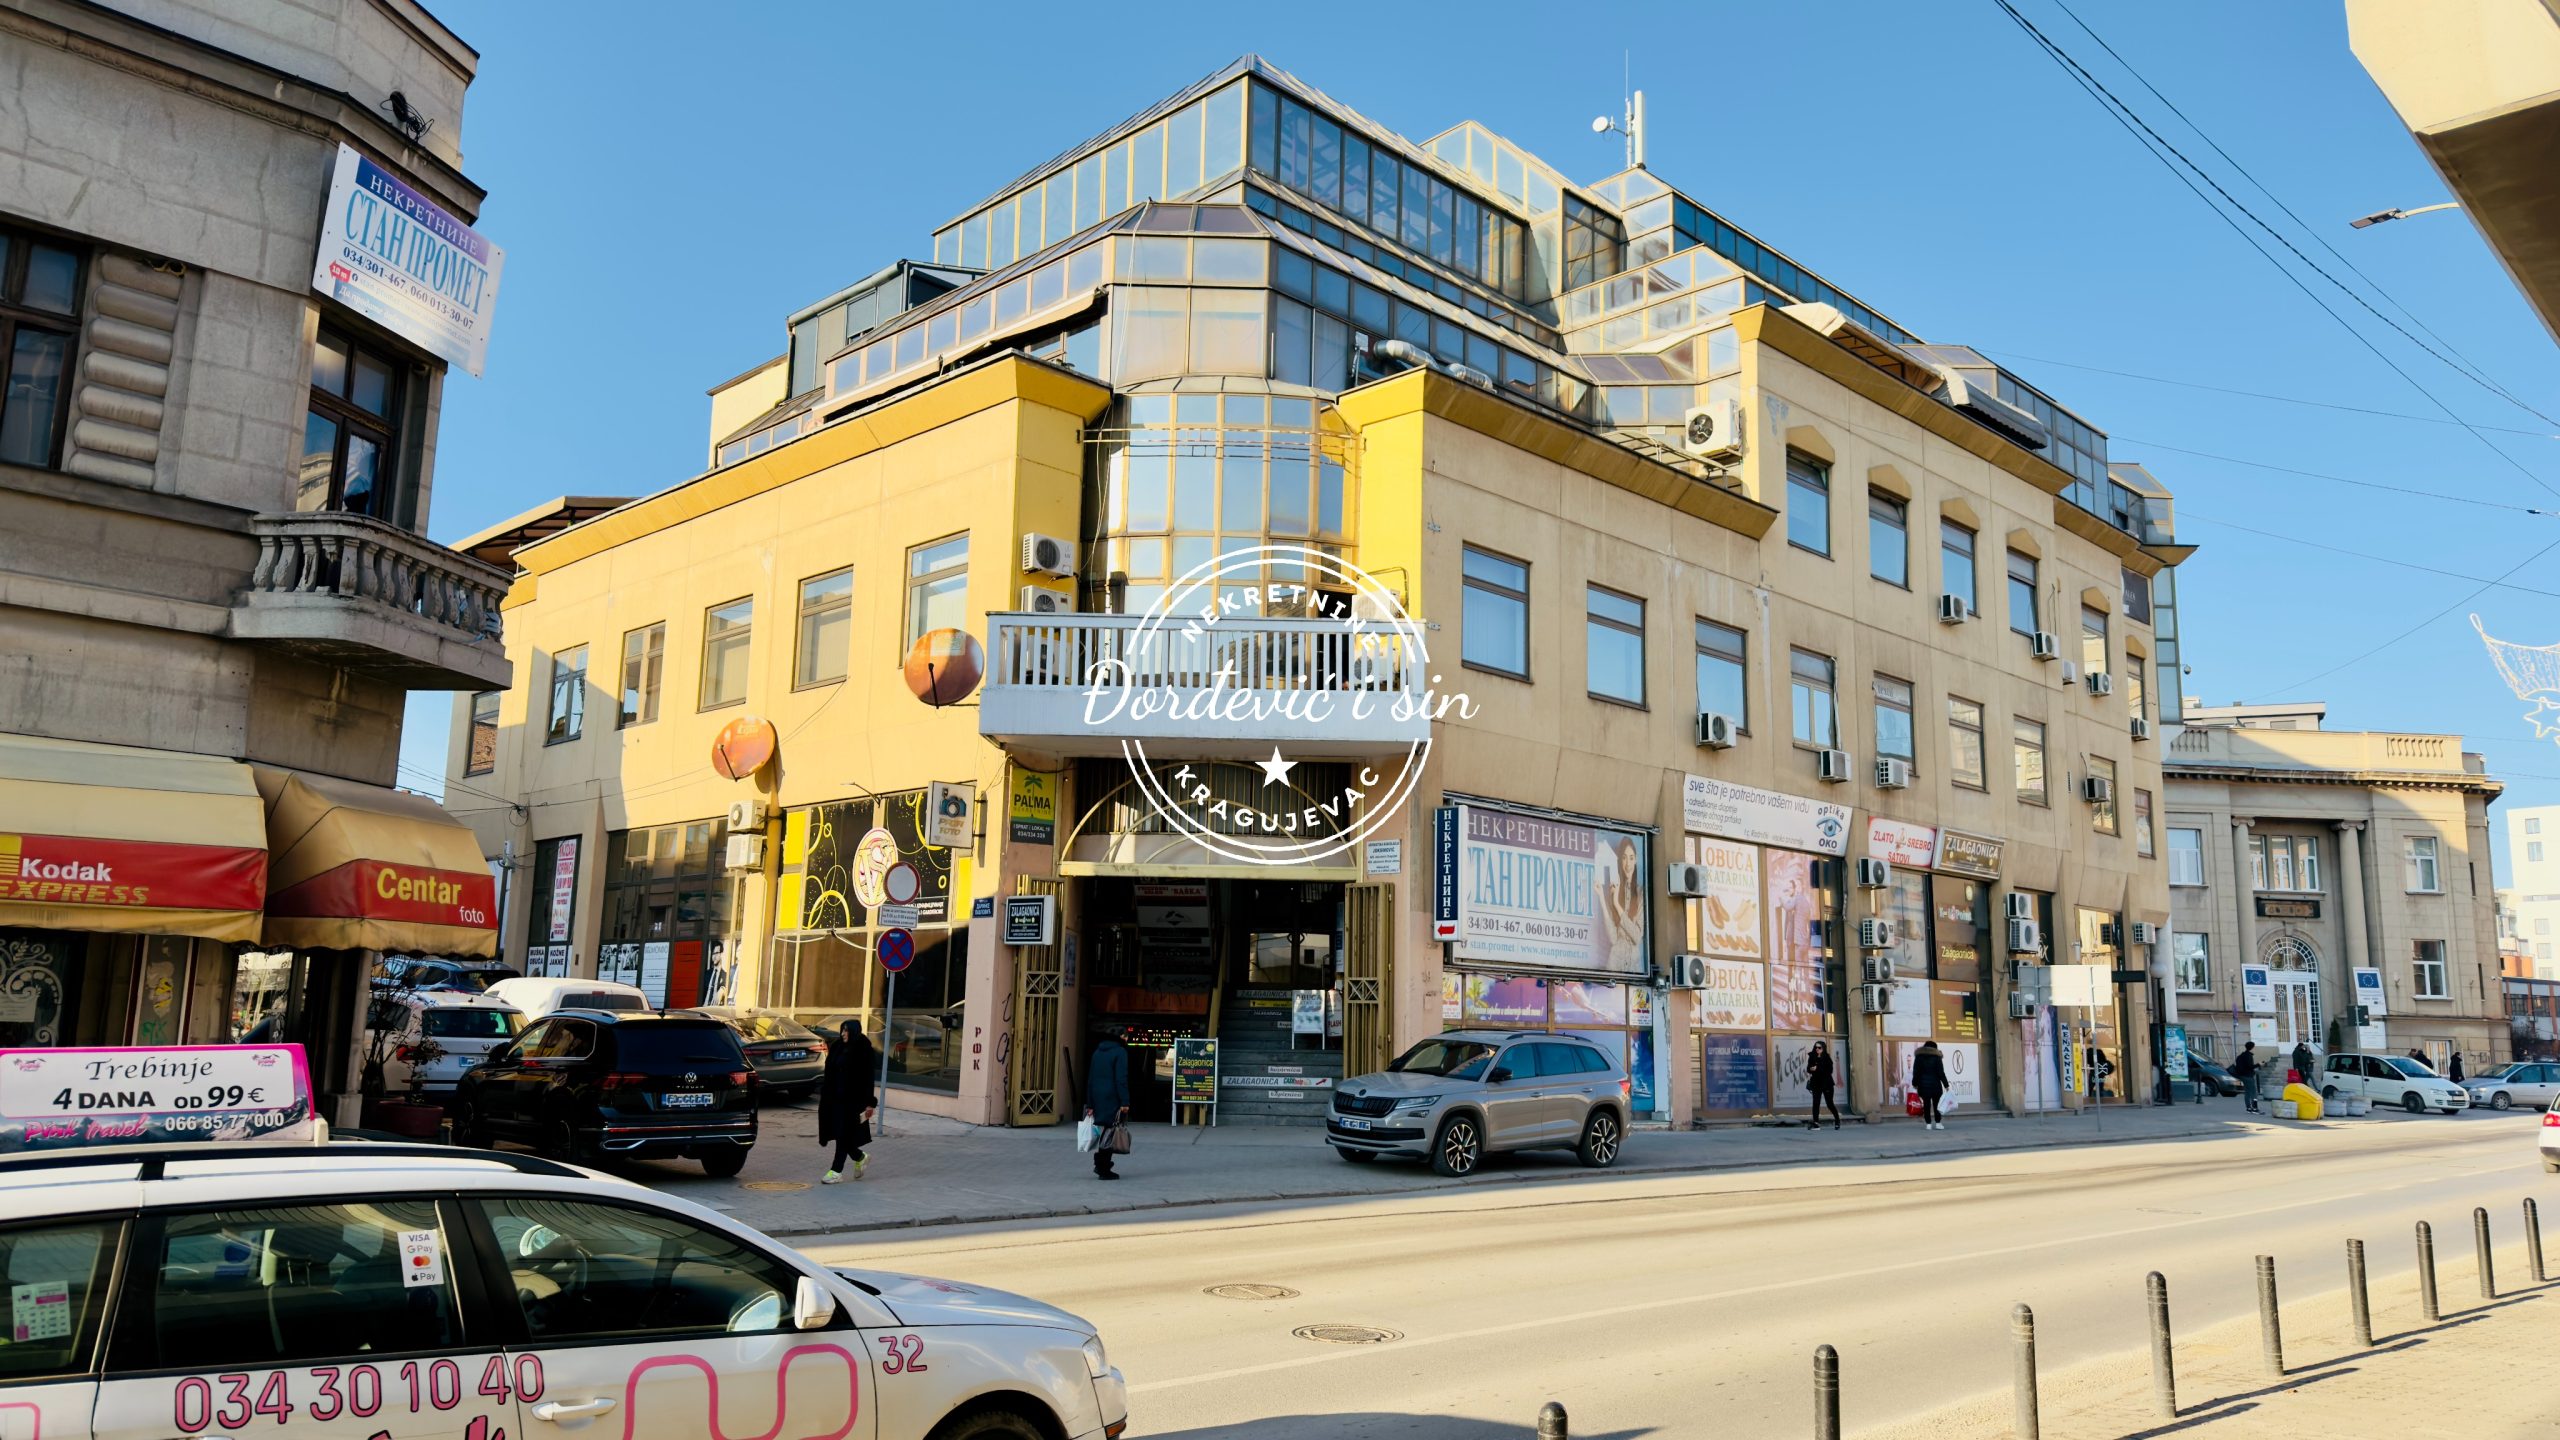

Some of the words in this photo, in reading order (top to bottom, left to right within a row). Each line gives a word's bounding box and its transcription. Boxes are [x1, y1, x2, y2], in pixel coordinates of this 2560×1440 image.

[369, 174, 479, 257] НЕКРЕТНИНЕ
[345, 189, 408, 268] СТАН
[404, 224, 489, 315] ПРОМЕТ
[1013, 793, 1051, 810] PALMA
[1689, 779, 1705, 793] sve
[1706, 782, 1719, 796] šta
[1719, 785, 1728, 800] je
[1729, 786, 1766, 806] potrebno
[1767, 793, 1793, 810] vašem
[1794, 799, 1810, 814] vidu
[1817, 804, 1845, 821] optika
[1468, 813, 1591, 853] НЕКРЕТНИНЕ
[1873, 831, 1895, 843] ZLATO
[1907, 838, 1932, 851] SREBRO
[1818, 838, 1838, 849] OKO
[1945, 837, 1999, 859] ZALAGAONICA
[1442, 809, 1452, 919] НЕКРЕТНИНЕ
[1705, 847, 1754, 873] OBUĆA
[1887, 851, 1911, 864] SATOVI
[21, 857, 113, 882] Kodak
[376, 867, 463, 905] Centar
[1467, 845, 1513, 908] ТАН
[1517, 852, 1595, 917] ПРОМЕТ
[0, 879, 150, 905] EXPRESS
[459, 906, 485, 924] foto
[1010, 905, 1040, 917] ZALAGAONICA
[1525, 922, 1589, 941] 060/013-30-07
[549, 948, 565, 957] KOŽNE
[1470, 940, 1516, 954] stan.promet
[1941, 945, 1975, 961] Zalagaonica
[549, 957, 564, 966] JAKNE
[1708, 991, 1760, 1008] KATARINA
[85, 1056, 214, 1085] Trebinje
[1178, 1056, 1214, 1068] Zalagaonica
[1226, 1077, 1279, 1085] ZALAGAONICA
[53, 1088, 73, 1110] 4
[78, 1091, 156, 1110] DANA
[174, 1096, 203, 1109] OD
[24, 1119, 79, 1143] Pink
[84, 1113, 150, 1140] travel
[165, 1116, 197, 1132] 066
[202, 1115, 223, 1130] 85
[229, 1114, 249, 1130] 77
[253, 1112, 285, 1128] 000
[408, 1233, 431, 1242] VISA
[416, 1245, 433, 1254] Pay
[419, 1272, 436, 1281] Pay
[878, 1333, 928, 1375] 32
[174, 1370, 294, 1433] 034
[310, 1364, 383, 1421] 30
[400, 1358, 461, 1413] 10
[478, 1353, 545, 1405] 40
